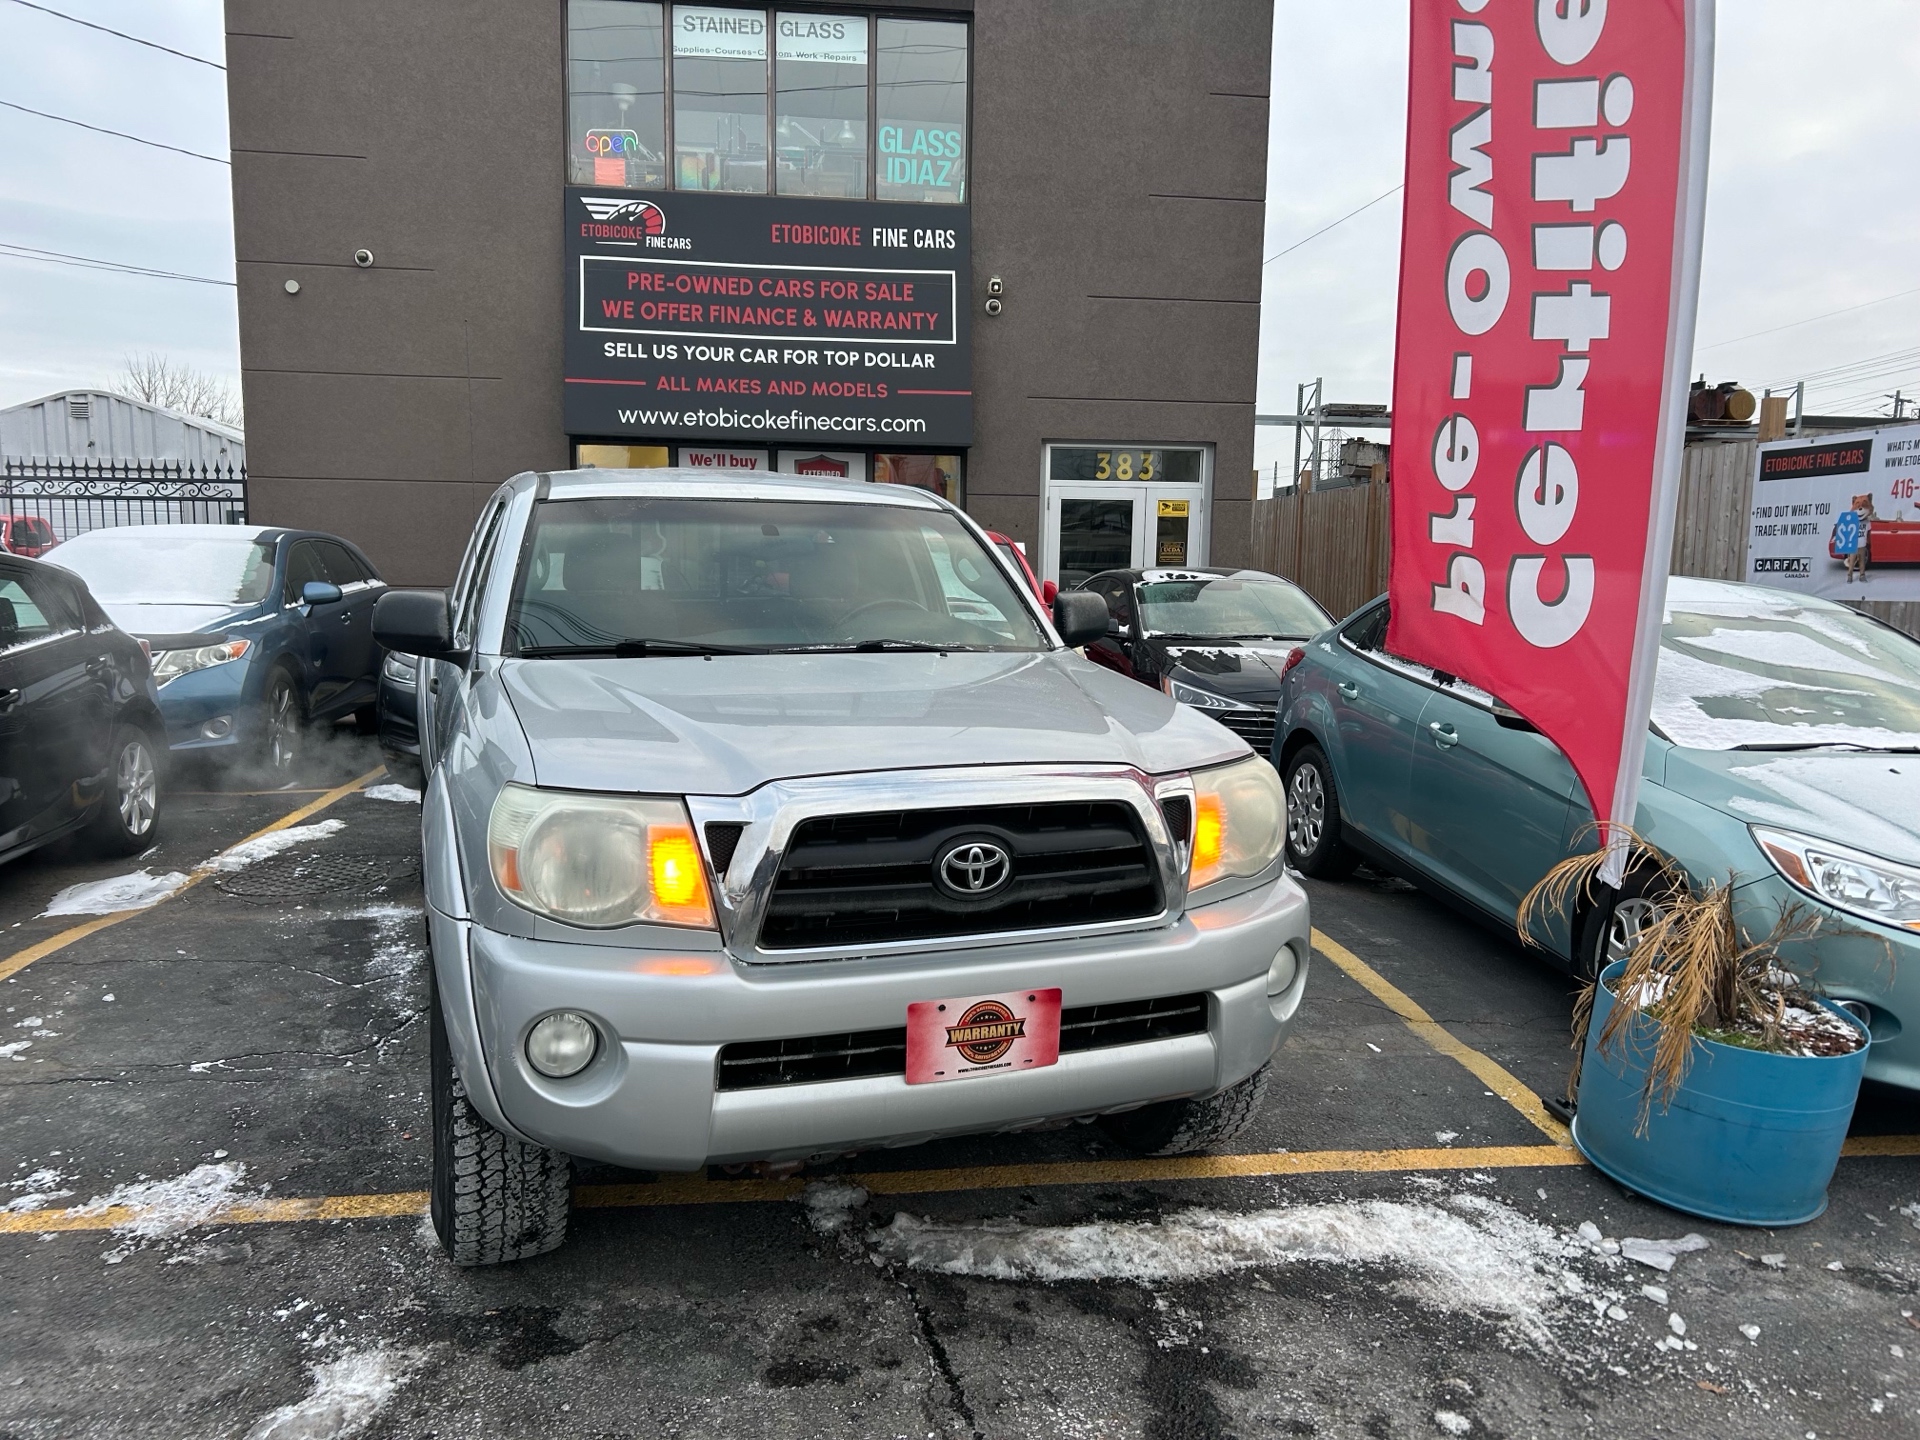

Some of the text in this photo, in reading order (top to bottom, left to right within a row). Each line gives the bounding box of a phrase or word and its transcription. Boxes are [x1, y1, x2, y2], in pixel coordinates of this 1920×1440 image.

[682, 15, 845, 40] STAINED GLASS
[586, 135, 636, 157] open
[879, 126, 961, 158] GLASS
[887, 157, 951, 187] IDIAZ
[581, 223, 642, 239] ETOBICOKE
[646, 236, 692, 250] FINE CARS
[771, 224, 956, 250] ETOBICOKE FINE CARS
[627, 272, 914, 302] PRE-OWNED CARS FOR SALE
[602, 299, 939, 331] WE OFFER FINANCE & WARRANTY
[604, 342, 935, 368] SELL US YOUR CAR FOR TOP DOLLAR
[656, 376, 888, 398] ALL MAKES AND MODELS
[618, 407, 926, 433] www.etobicokefinecars.com
[1887, 440, 1912, 453] WHAT'S
[689, 453, 758, 471] We'll buy
[1095, 453, 1154, 480] 383
[1765, 449, 1865, 473] ETOBICOKE FINE CARS
[1755, 503, 1831, 519] FIND OUT WHAT YOU
[1754, 522, 1820, 537] TRADE-IN WORTH.
[950, 1022, 1021, 1043] WARRANTY
